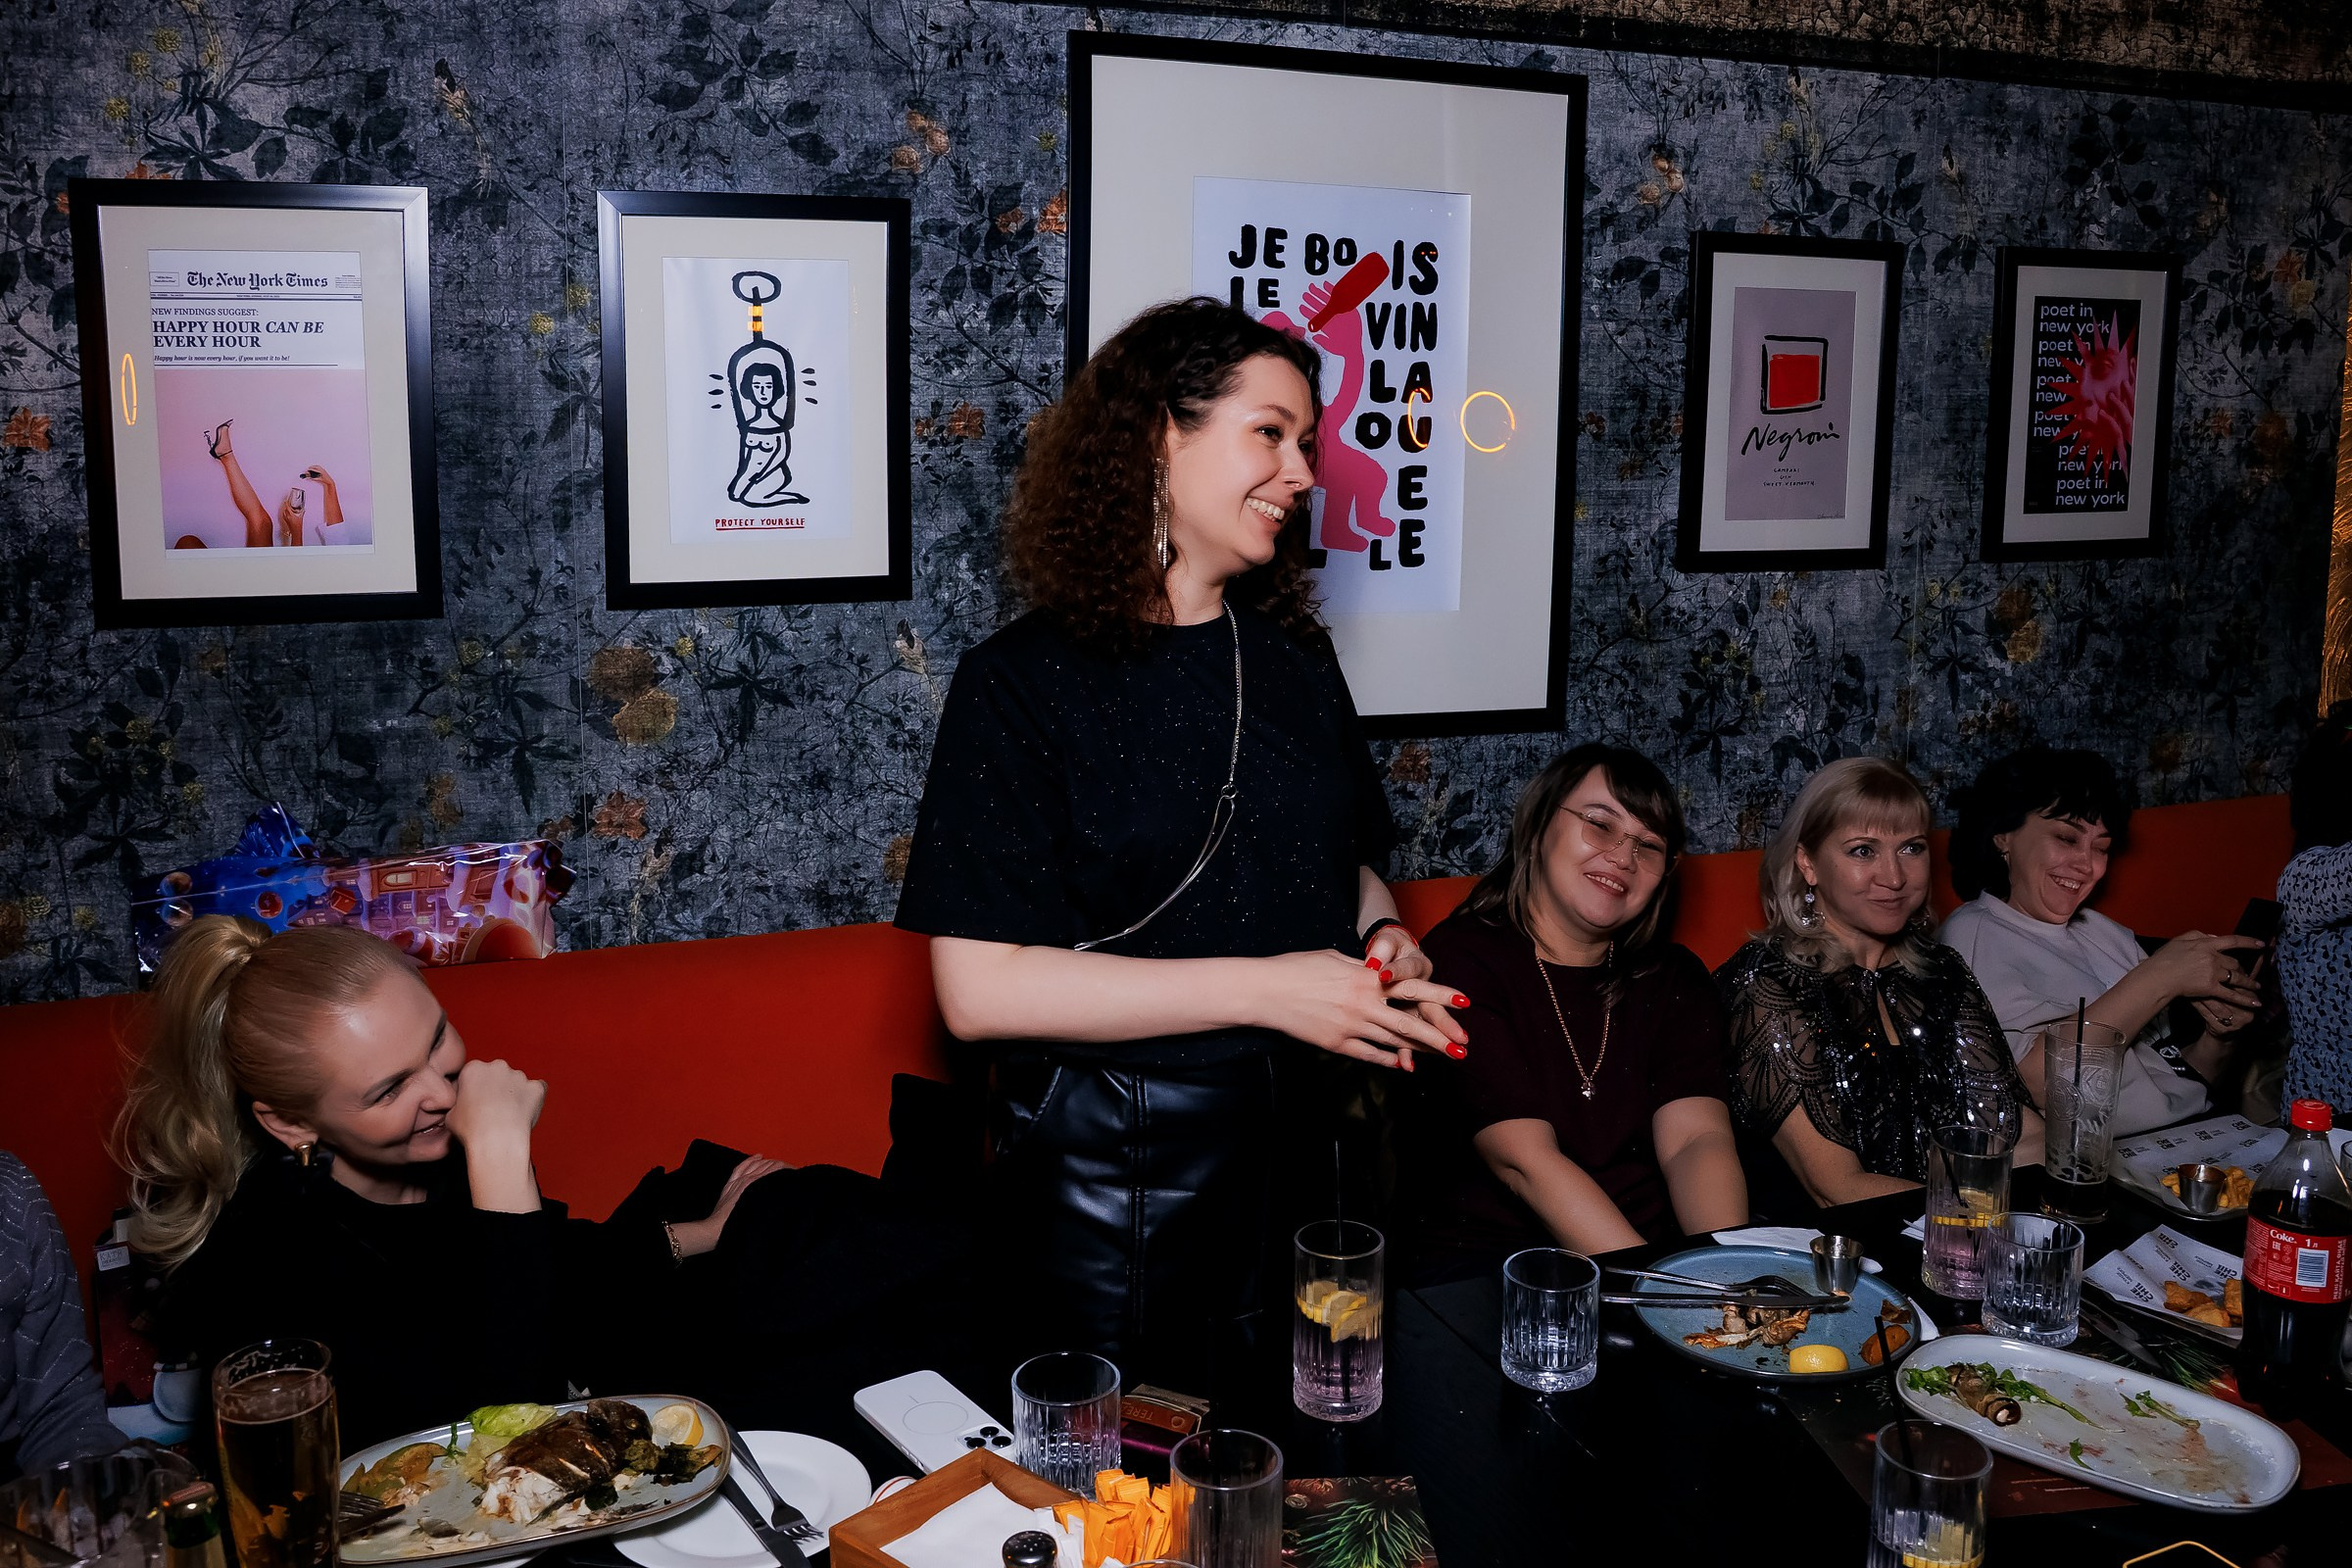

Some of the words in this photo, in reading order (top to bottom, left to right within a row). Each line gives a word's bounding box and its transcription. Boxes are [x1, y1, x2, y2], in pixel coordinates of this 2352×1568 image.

[1228, 223, 1288, 270] JE
[187, 271, 214, 288] The
[216, 272, 246, 287] New
[249, 272, 283, 291] York
[286, 272, 328, 287] Times
[2040, 304, 2076, 319] poet
[2080, 302, 2093, 318] in
[153, 320, 209, 333] HAPPY
[213, 320, 262, 333] HOUR
[266, 321, 300, 333] CAN
[303, 321, 324, 333] BE
[1364, 302, 1439, 352] VIN
[2039, 321, 2072, 332] new
[153, 336, 209, 348] EVERY
[212, 336, 262, 348] HOUR
[2038, 338, 2074, 355] poet
[1369, 359, 1433, 404] LA
[2035, 391, 2067, 402] new
[1741, 421, 1840, 462] Negroni
[2056, 476, 2091, 493] poet
[2055, 495, 2087, 506] new
[2091, 491, 2126, 508] york
[715, 518, 755, 527] PROTECT
[760, 517, 806, 526] YOURSELF
[2270, 1229, 2294, 1244] Coke
